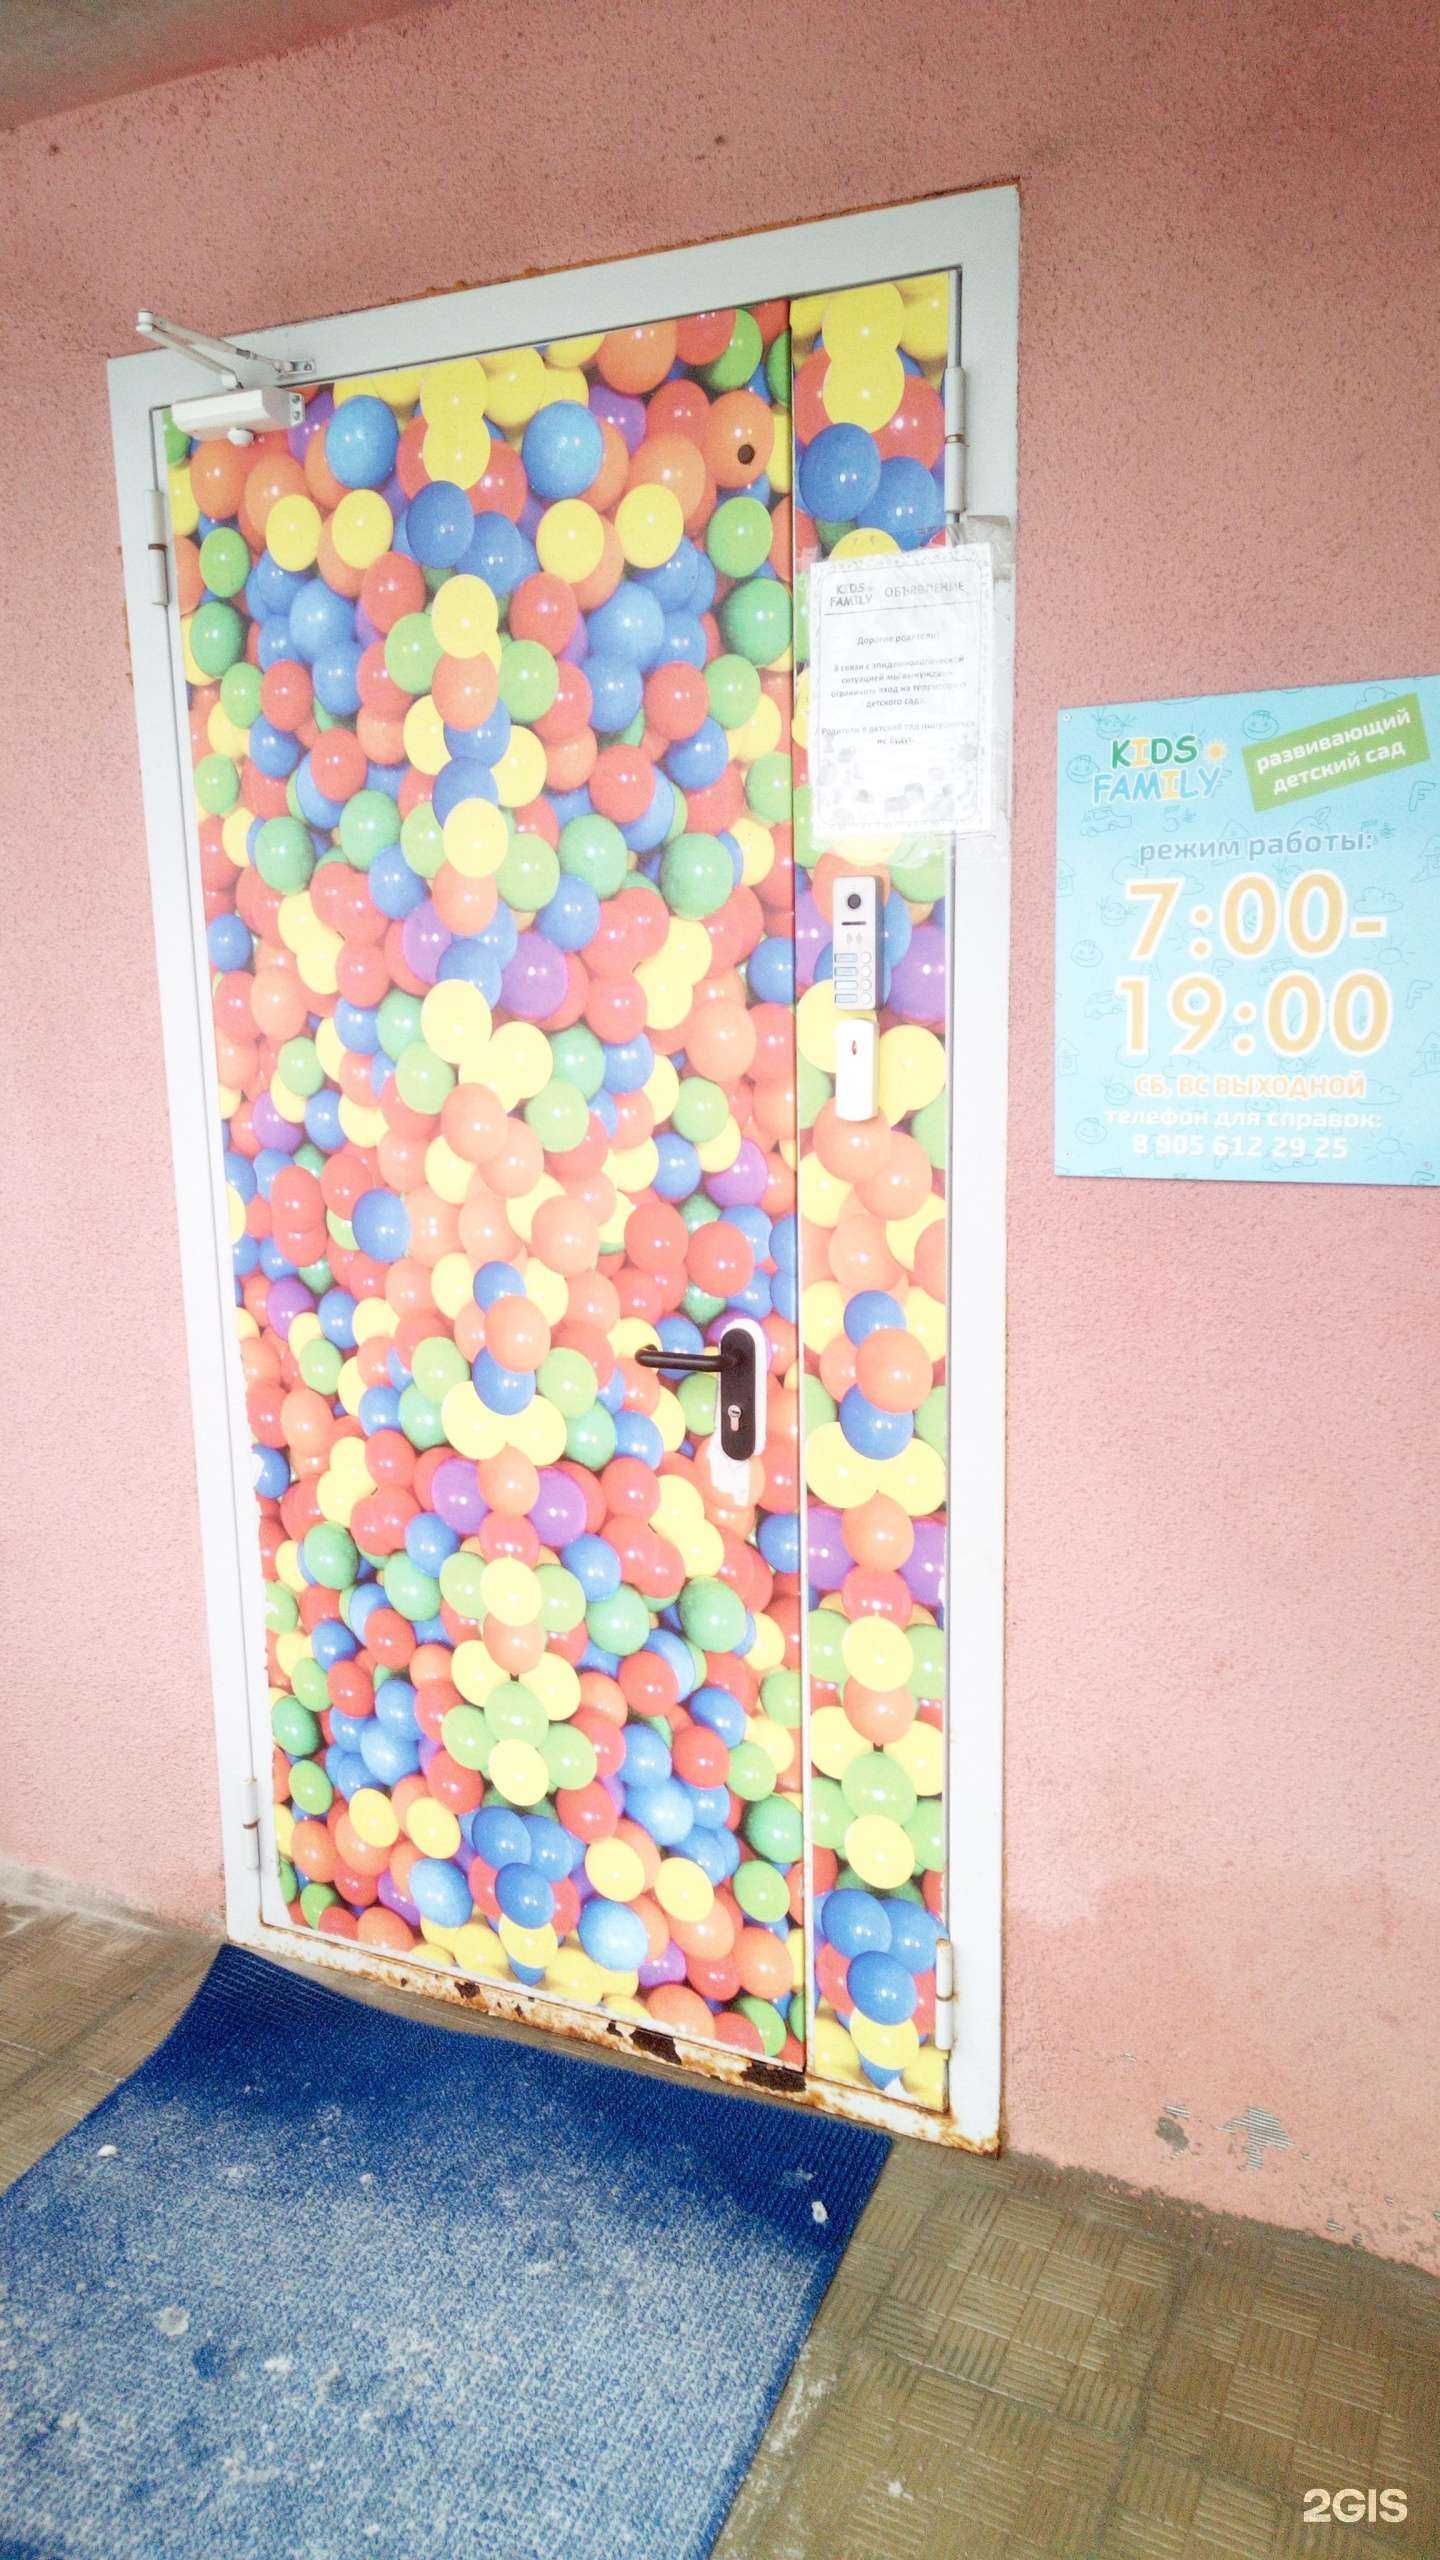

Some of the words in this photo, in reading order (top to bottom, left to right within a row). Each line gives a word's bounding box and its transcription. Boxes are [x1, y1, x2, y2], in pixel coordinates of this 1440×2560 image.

[829, 594, 873, 608] FAMILY
[1111, 735, 1198, 769] KIDS
[1256, 708, 1411, 775] развивающий
[1093, 766, 1221, 804] FAMILY
[1273, 751, 1362, 796] детский
[1365, 740, 1407, 764] сад
[1138, 839, 1240, 866] режим
[1249, 829, 1376, 861] работы:
[1117, 970, 1392, 1058] 19:00
[1178, 1075, 1209, 1096] ВС
[1215, 1069, 1367, 1100] ВЫХОДНОЙ
[1106, 1110, 1209, 1126] телефон
[1214, 1111, 1261, 1128] для
[1267, 1111, 1384, 1129] справок:
[1132, 1134, 1149, 1155] 8
[1155, 1135, 1205, 1156] 905
[1212, 1135, 1263, 1157] 612
[1270, 1137, 1307, 1158] 29
[1314, 1137, 1349, 1159] 25
